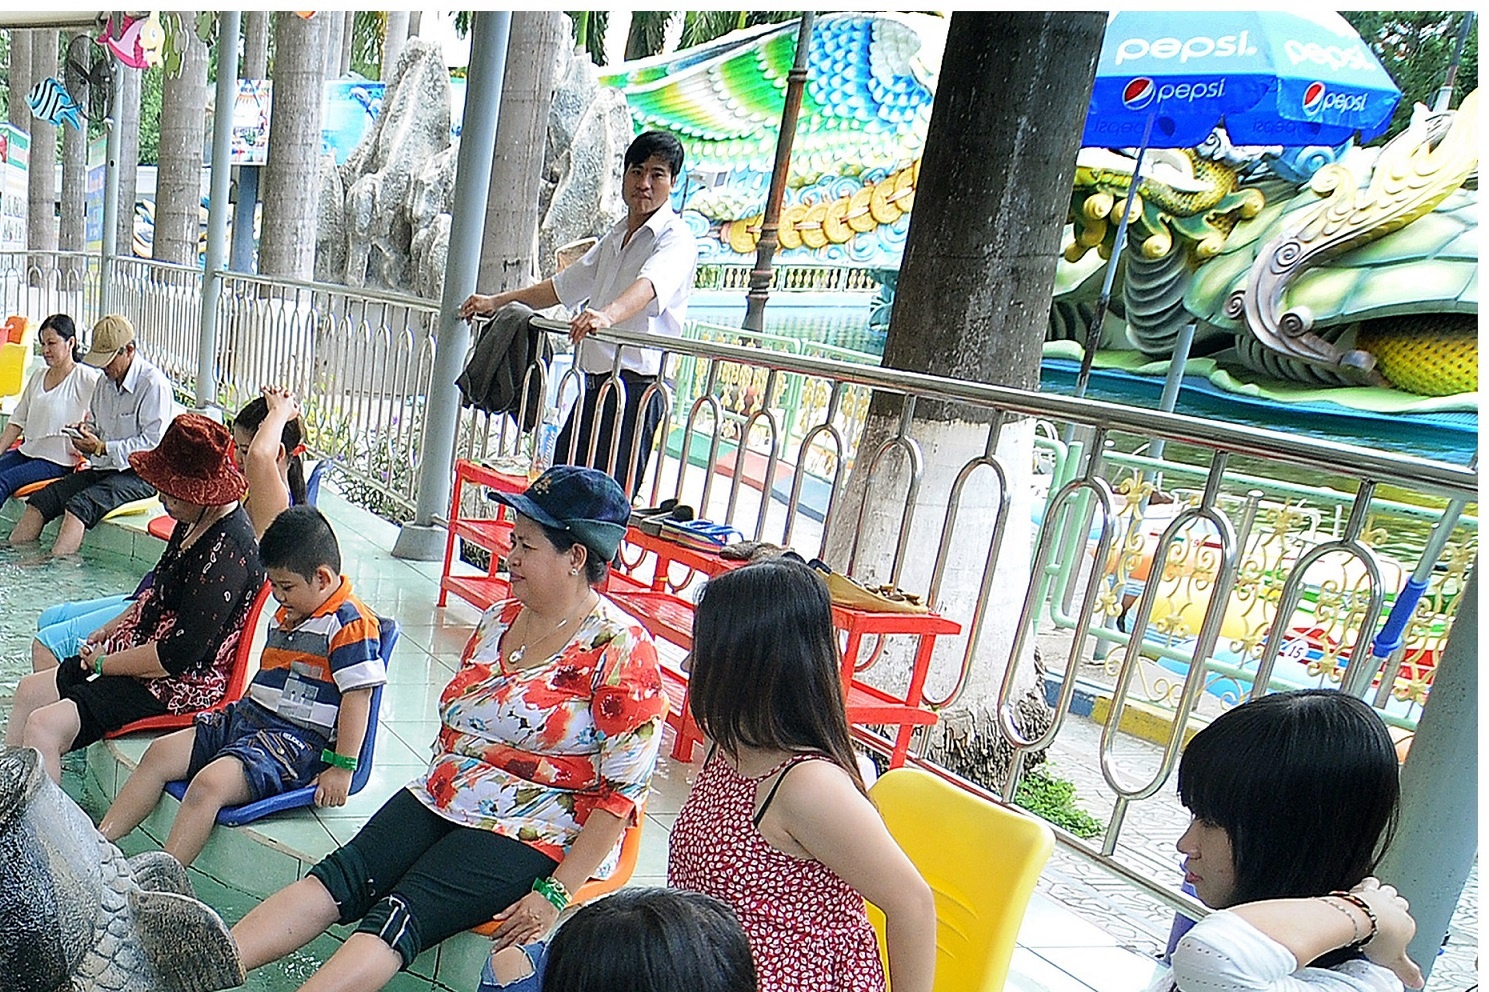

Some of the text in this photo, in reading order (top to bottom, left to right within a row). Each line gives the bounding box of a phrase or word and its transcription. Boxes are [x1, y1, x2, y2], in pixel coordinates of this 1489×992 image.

[1156, 78, 1226, 104] pepsi
[1322, 92, 1369, 114] pepsi
[1287, 645, 1304, 659] 15
